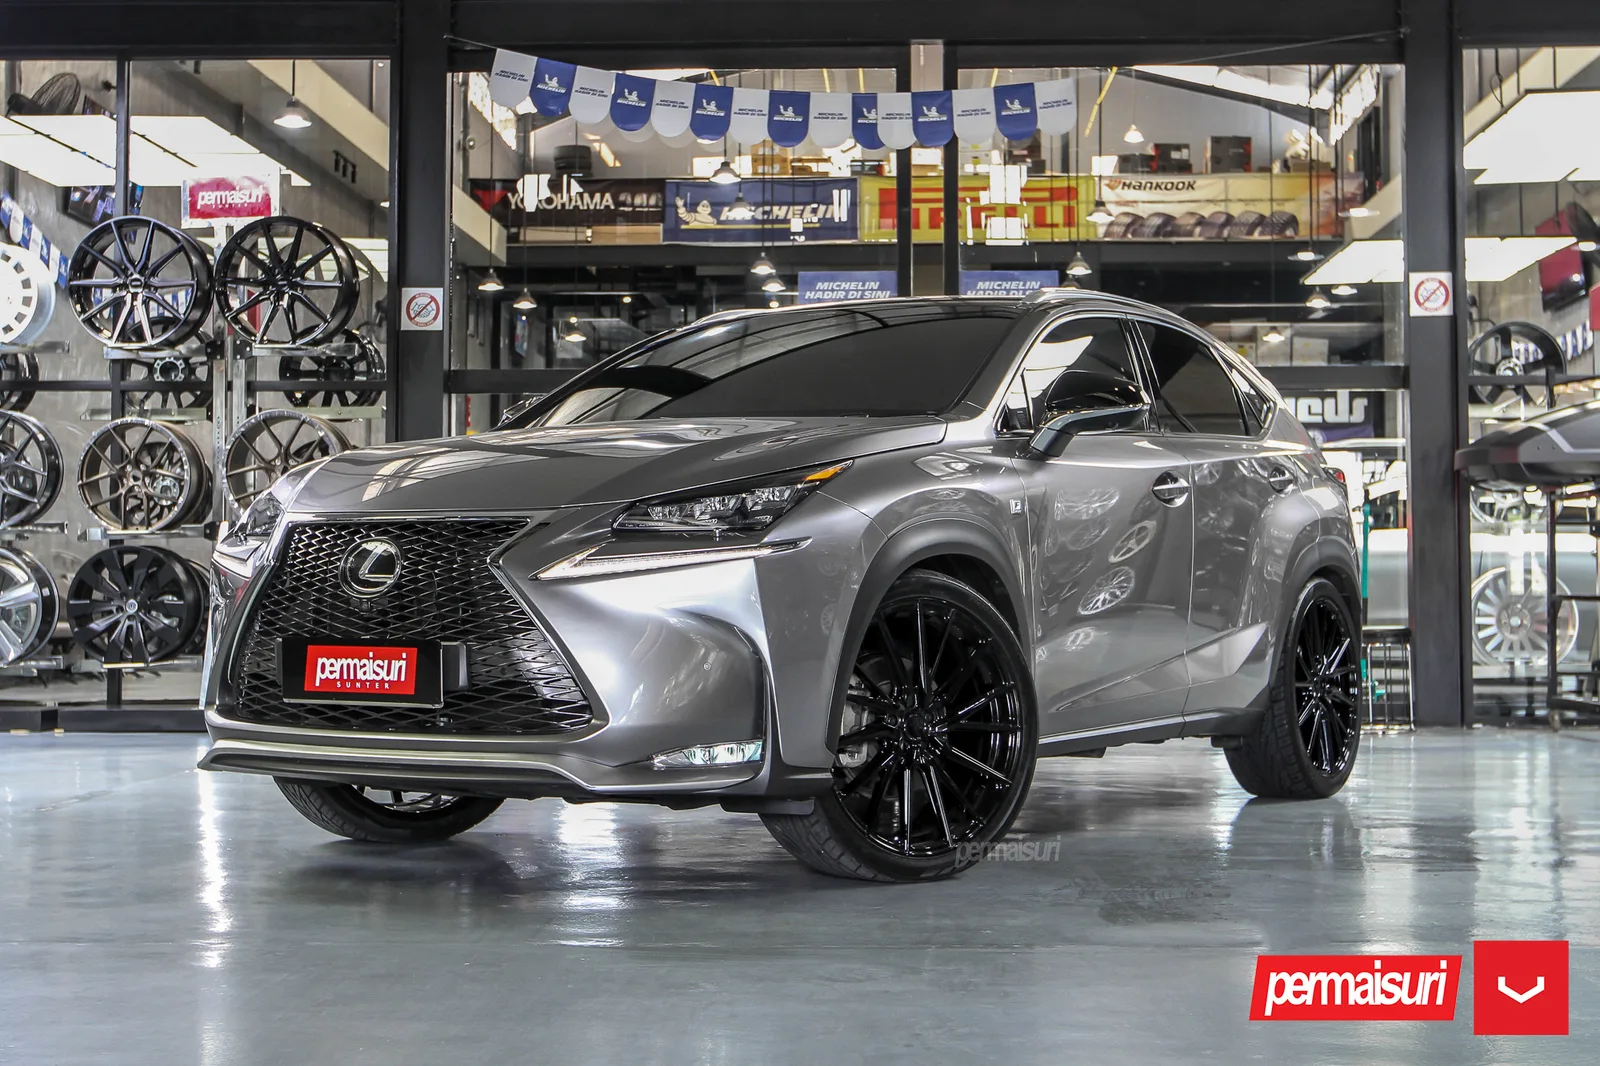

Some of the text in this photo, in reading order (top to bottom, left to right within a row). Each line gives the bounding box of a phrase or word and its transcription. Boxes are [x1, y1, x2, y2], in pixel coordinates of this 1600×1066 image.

[536, 84, 566, 93] MICHELIN
[616, 99, 646, 107] MICHELIN
[1001, 108, 1031, 116] MICHELIN
[197, 185, 263, 210] permaisuri
[507, 192, 615, 210] YOHAMA
[719, 204, 849, 221] CHELI
[878, 187, 1078, 230] PIRELI
[816, 281, 880, 290] MICHELIN
[976, 281, 1041, 290] MICHELIN
[804, 290, 891, 299] HADIR DI SINI
[315, 651, 407, 687] permaisuri
[336, 681, 390, 690] SUNTER
